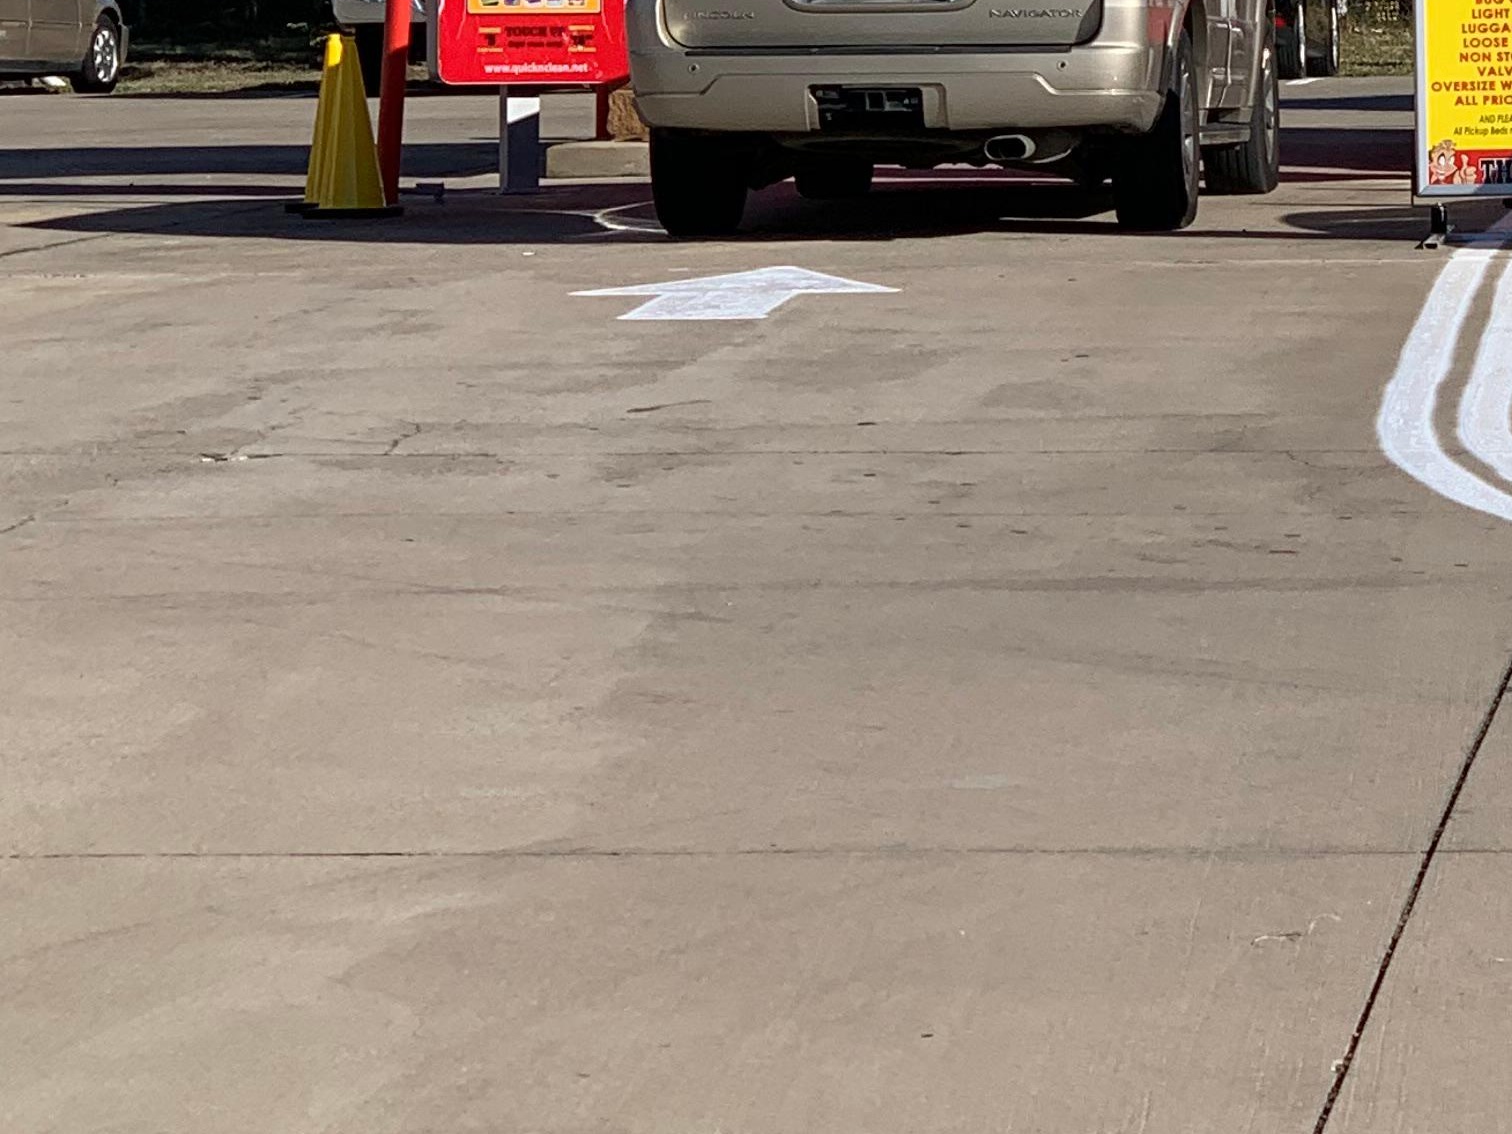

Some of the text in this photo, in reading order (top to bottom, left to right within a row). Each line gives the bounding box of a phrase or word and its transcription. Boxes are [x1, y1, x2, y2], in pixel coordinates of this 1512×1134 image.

[988, 9, 1083, 19] NAVIGATOR
[1471, 8, 1510, 19] LIGHT
[1463, 37, 1508, 48] LOOSE
[1459, 52, 1492, 62] NON
[1431, 80, 1496, 92] OVERSIZE
[1454, 95, 1478, 106] ALL
[1479, 114, 1496, 124] AND
[1464, 125, 1489, 137] Pickup
[1490, 125, 1508, 136] Beds
